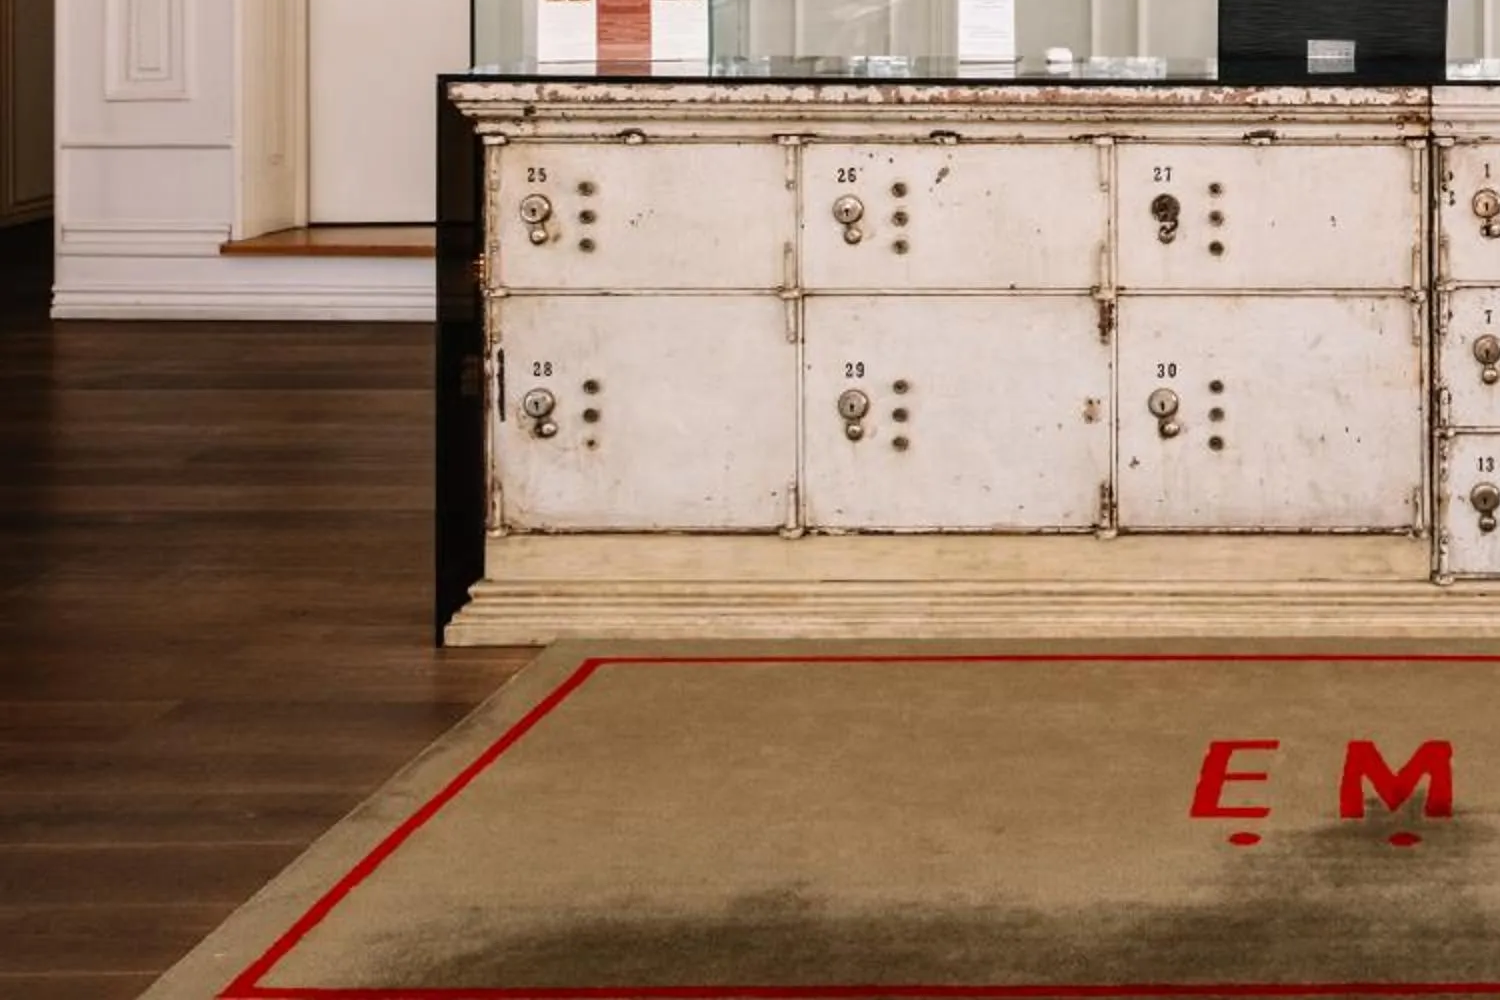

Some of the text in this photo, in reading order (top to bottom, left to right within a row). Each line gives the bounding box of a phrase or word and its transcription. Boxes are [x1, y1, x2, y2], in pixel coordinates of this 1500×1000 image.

[527, 167, 547, 183] 25
[837, 167, 857, 183] 26
[1153, 166, 1172, 183] 27
[1484, 163, 1491, 179] 1
[1484, 309, 1493, 325] 7
[533, 361, 553, 377] 28
[845, 361, 865, 379] 29
[1156, 362, 1177, 379] 30
[1478, 456, 1495, 473] 13
